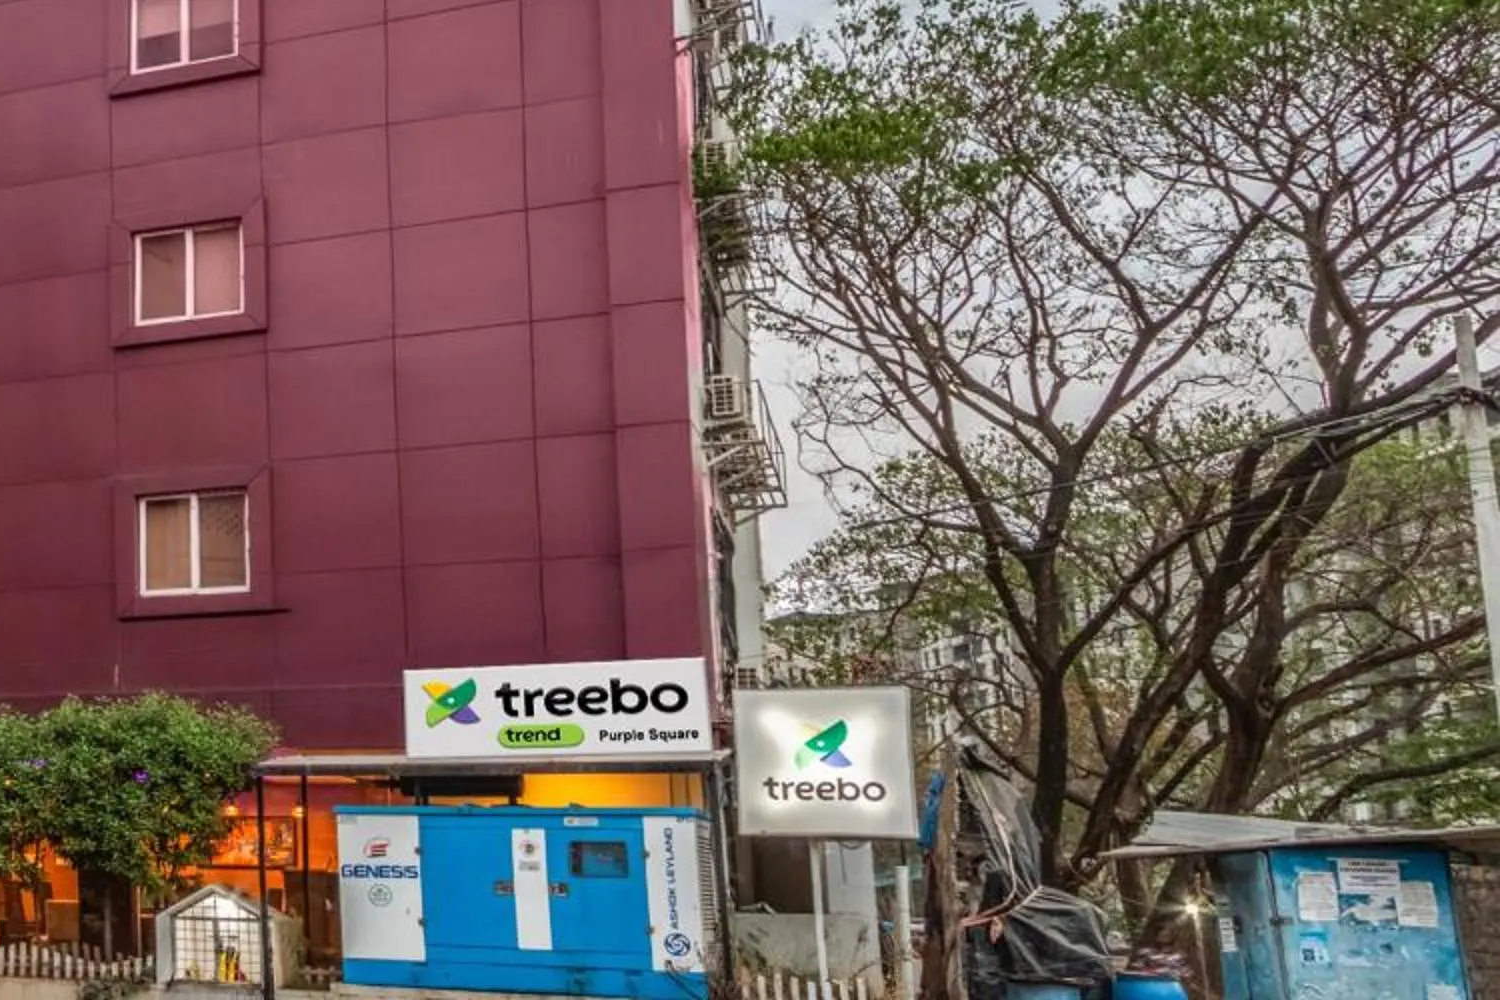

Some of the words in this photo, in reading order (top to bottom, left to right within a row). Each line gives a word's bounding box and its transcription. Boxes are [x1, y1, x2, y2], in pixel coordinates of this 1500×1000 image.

[495, 678, 689, 718] treebo
[506, 727, 561, 743] trend
[599, 729, 645, 743] Purple
[650, 728, 699, 742] Square
[763, 777, 886, 801] treebo
[664, 827, 675, 884] LEYLAND
[668, 887, 678, 929] ASHOK
